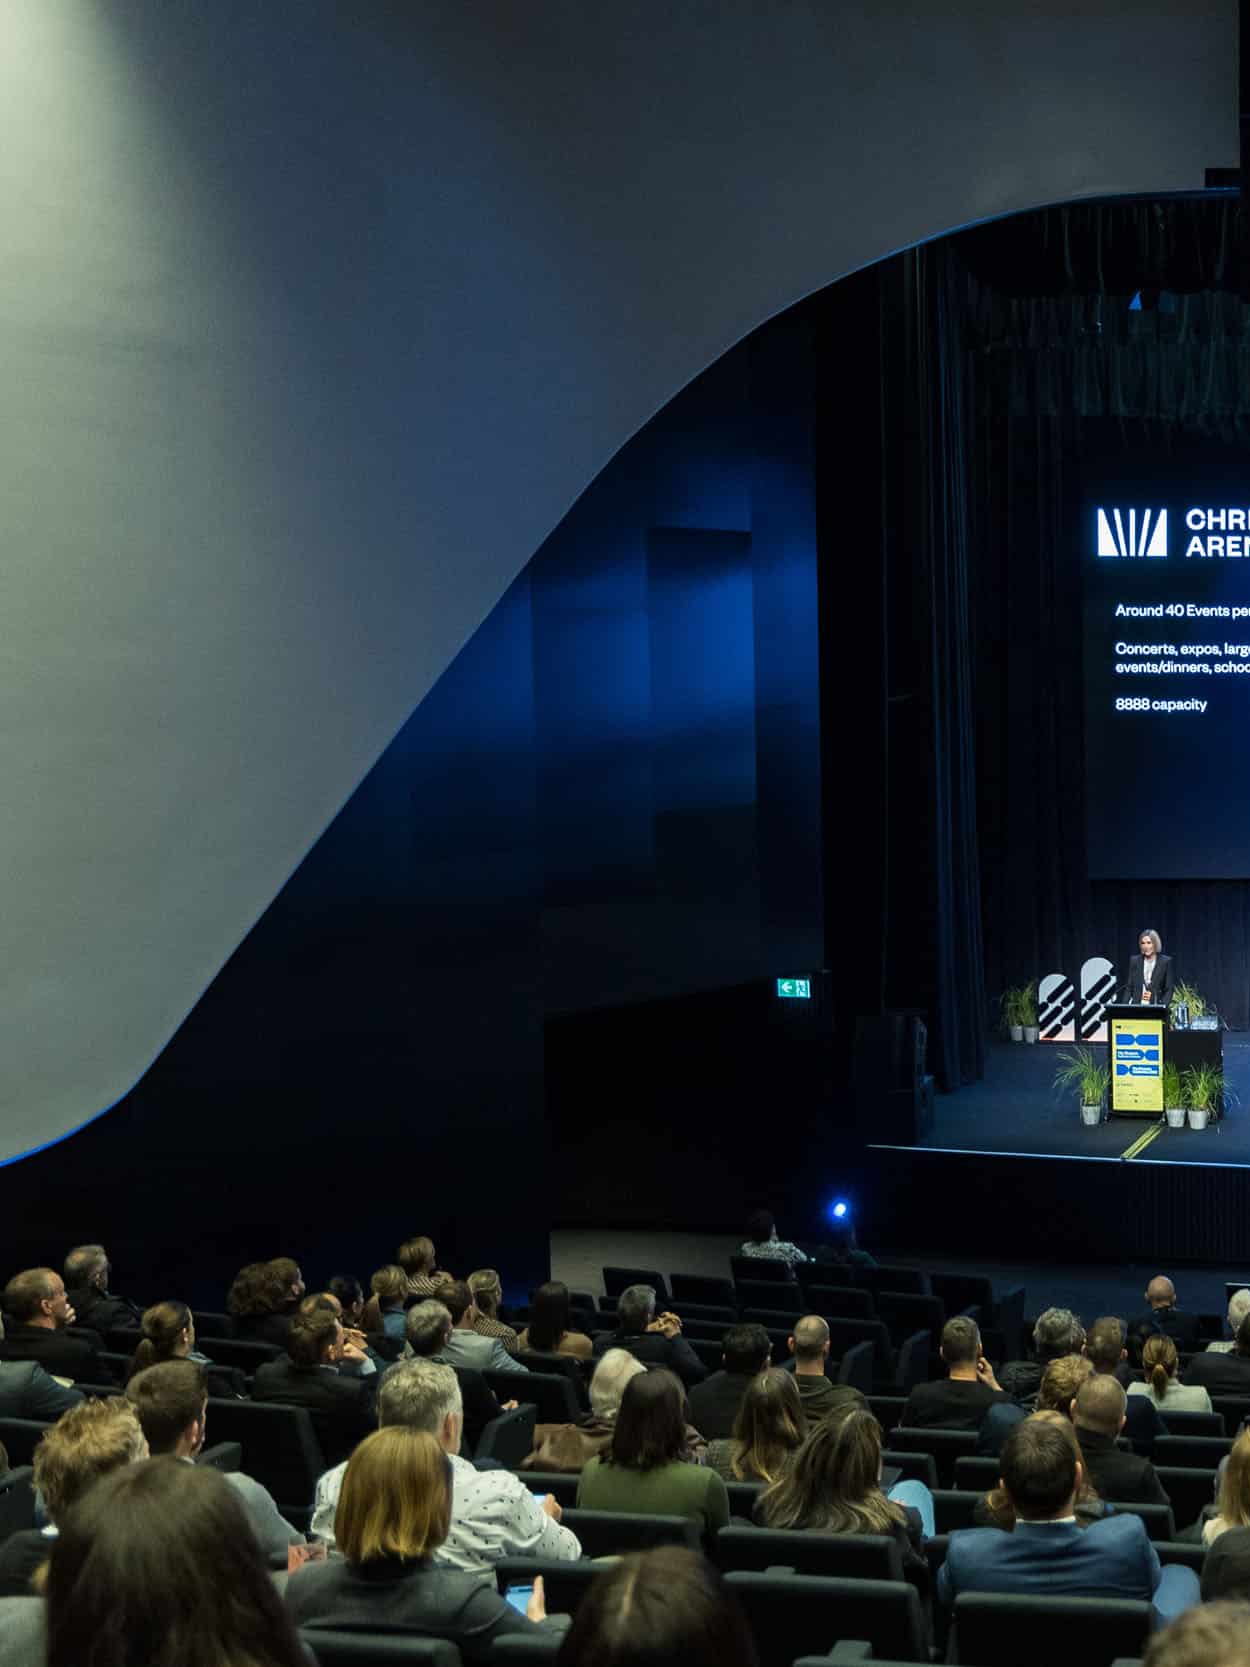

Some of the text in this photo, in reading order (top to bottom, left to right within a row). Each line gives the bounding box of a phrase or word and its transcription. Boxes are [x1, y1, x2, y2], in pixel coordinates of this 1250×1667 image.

[1115, 604, 1163, 617] Around
[1165, 604, 1184, 617] 40
[1187, 604, 1230, 617] Events
[1115, 642, 1178, 657] Concerts,
[1180, 645, 1222, 657] expos,
[1115, 660, 1212, 675] events/dinners,
[1115, 698, 1207, 712] 8888 capacity
